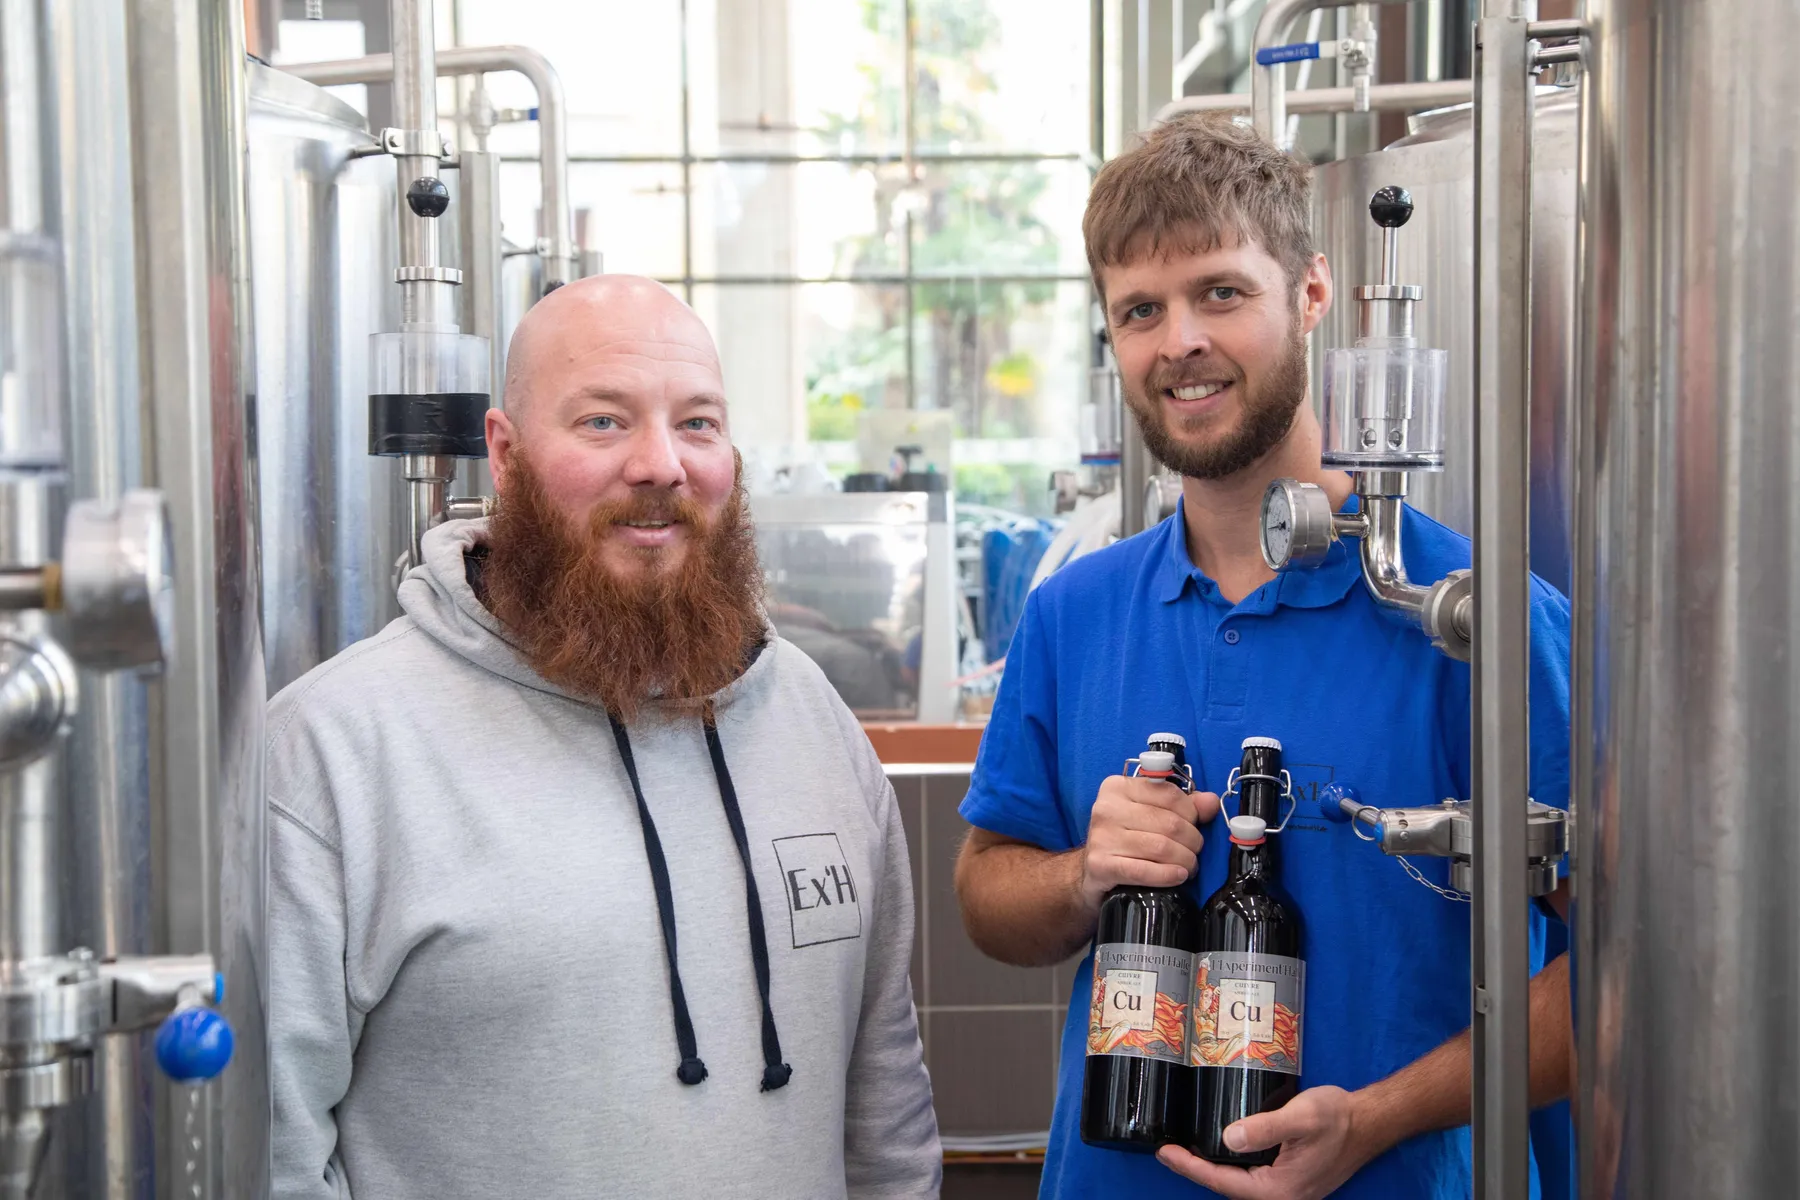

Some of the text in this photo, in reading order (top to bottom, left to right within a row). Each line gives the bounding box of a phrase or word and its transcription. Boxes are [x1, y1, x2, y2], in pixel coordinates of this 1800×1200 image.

[787, 864, 856, 911] Ex'H
[1113, 990, 1142, 1011] Cu
[1230, 1000, 1262, 1022] Cu
